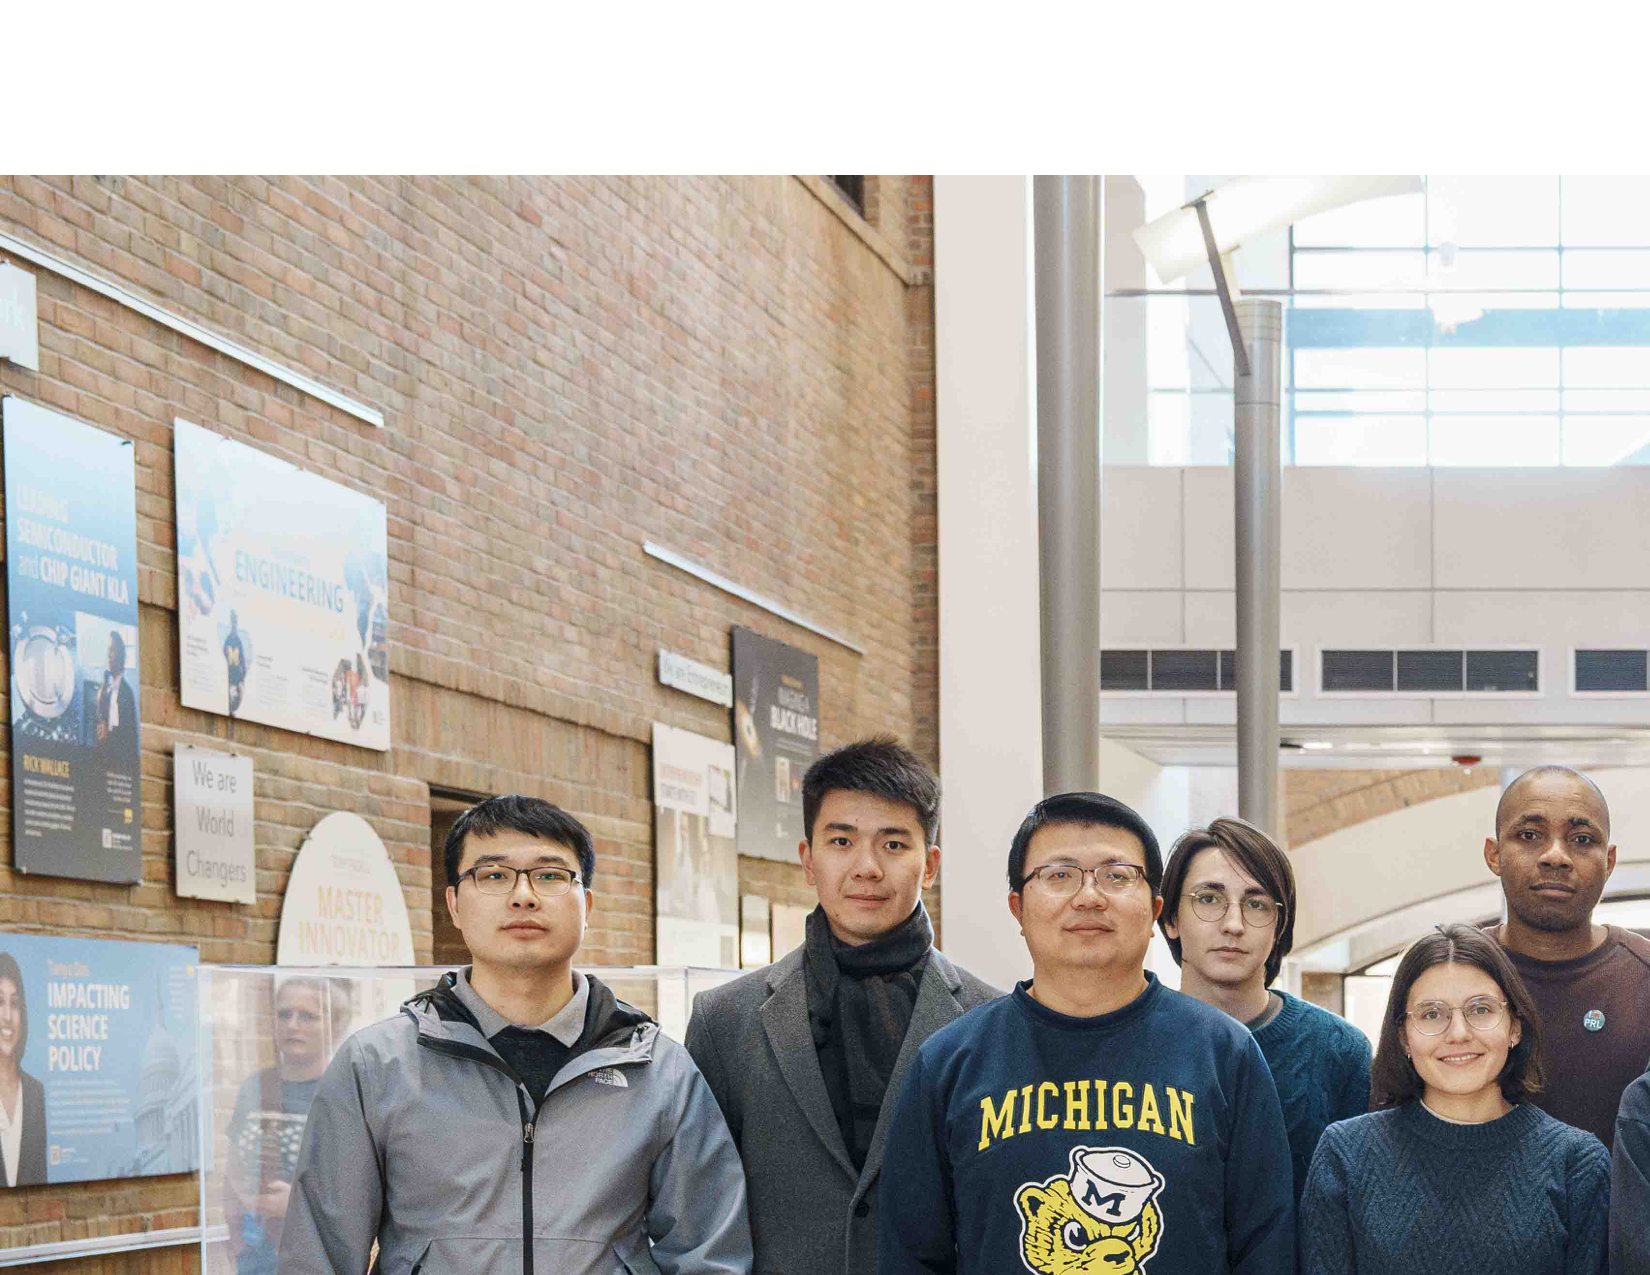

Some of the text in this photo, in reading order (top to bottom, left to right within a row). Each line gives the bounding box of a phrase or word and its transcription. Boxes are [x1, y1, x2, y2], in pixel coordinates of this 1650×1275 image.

[17, 516, 119, 571] SEMICONDUCTOR
[40, 557, 68, 587] CHIP
[70, 564, 105, 597] GIANT
[107, 575, 131, 605] KLA
[235, 549, 343, 614] ENGINEERING
[770, 704, 818, 741] BLACK HOLE
[192, 760, 237, 793] We are
[196, 806, 234, 837] World
[186, 849, 247, 888] Changers
[317, 885, 383, 925] MASTER
[298, 919, 400, 961] INNOVATOR
[47, 981, 131, 1010] IMPACTING
[47, 1013, 108, 1040] SCIENCE
[48, 1045, 102, 1073] POLICY
[588, 1070, 613, 1080] NORTH
[595, 1077, 613, 1086] FACE
[978, 1079, 1195, 1151] MICHIGAN
[1081, 1178, 1126, 1217] M
